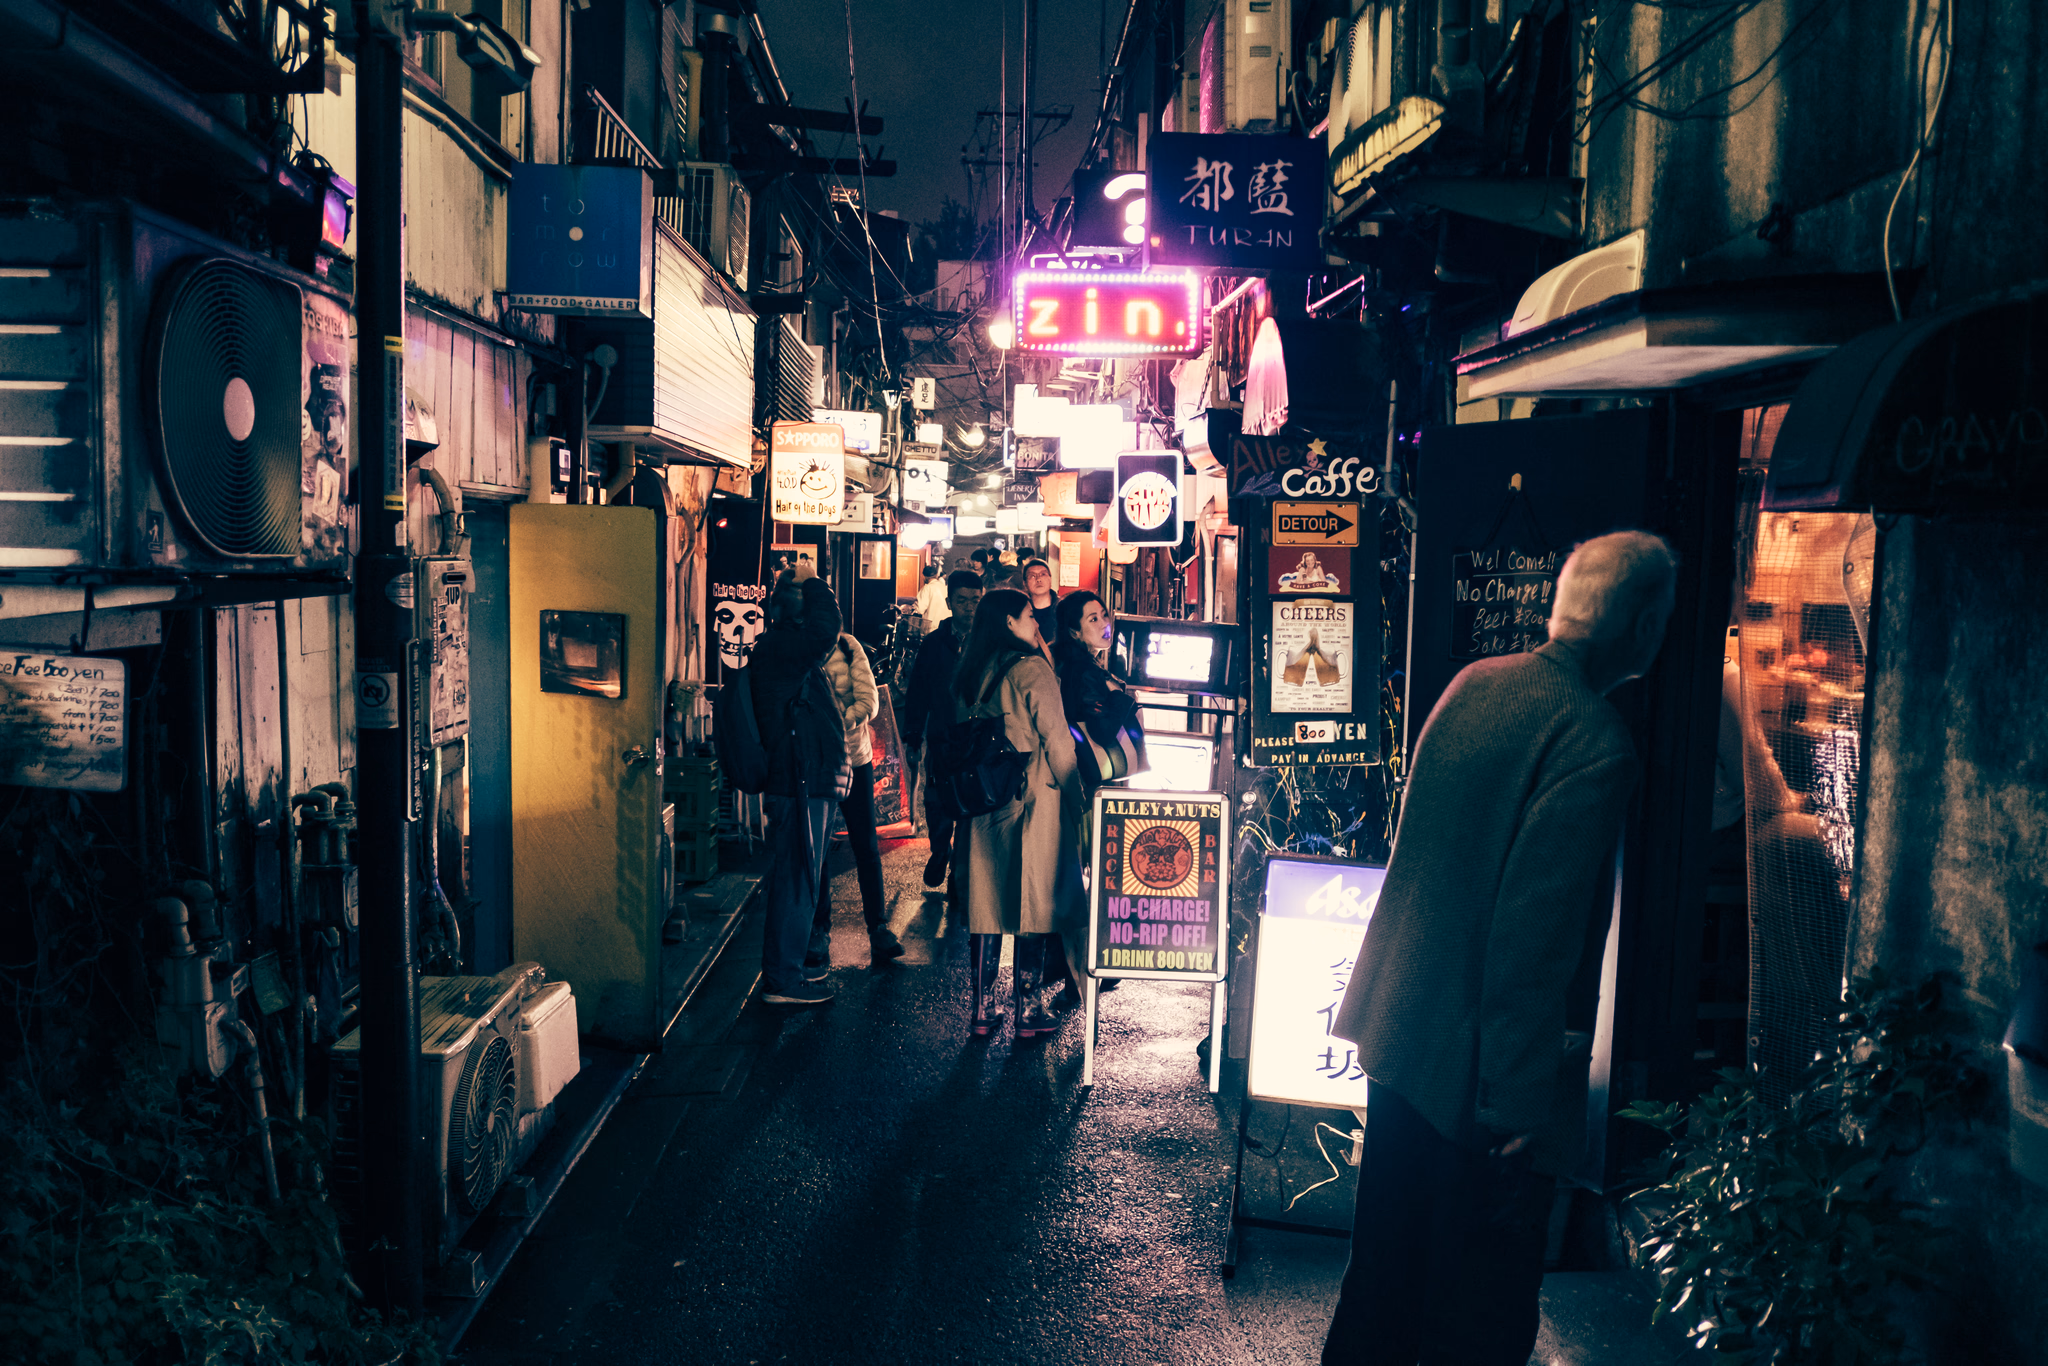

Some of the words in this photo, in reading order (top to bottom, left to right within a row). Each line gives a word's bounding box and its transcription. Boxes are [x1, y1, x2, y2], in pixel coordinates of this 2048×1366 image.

[1178, 156, 1295, 218] 都藍
[1183, 225, 1293, 248] TURAN
[904, 445, 937, 454] GHETTO
[1281, 456, 1381, 497] Caffe
[776, 499, 792, 514] Hair
[804, 501, 816, 514] the
[1282, 517, 1338, 531] DETOUR
[1471, 550, 1499, 570] Wel
[446, 586, 460, 605] 1UP
[713, 583, 728, 598] Hair
[736, 584, 748, 600] the
[1456, 580, 1482, 602] No
[1280, 607, 1346, 622] CHEERS
[1473, 608, 1510, 630] Beer
[13, 655, 40, 676] Fee
[44, 659, 68, 678] 500
[70, 668, 104, 682] yen
[62, 708, 86, 718] from
[1255, 736, 1294, 748] PLEASE
[1298, 724, 1326, 741] 800
[1334, 722, 1367, 740] YEN
[1272, 753, 1292, 764] PAY
[1298, 753, 1309, 763] IN
[1316, 752, 1366, 763] ADVANCE
[1104, 824, 1119, 890] ROCK
[1204, 834, 1216, 883] BAR
[1108, 896, 1210, 922] NO-CHARGE!
[1110, 922, 1168, 946] NO-RIP
[1172, 924, 1207, 948] OFF!
[1102, 948, 1109, 966] 1
[1112, 950, 1155, 968] DRINK
[1157, 951, 1185, 969] 800
[1187, 952, 1212, 971] YEN
